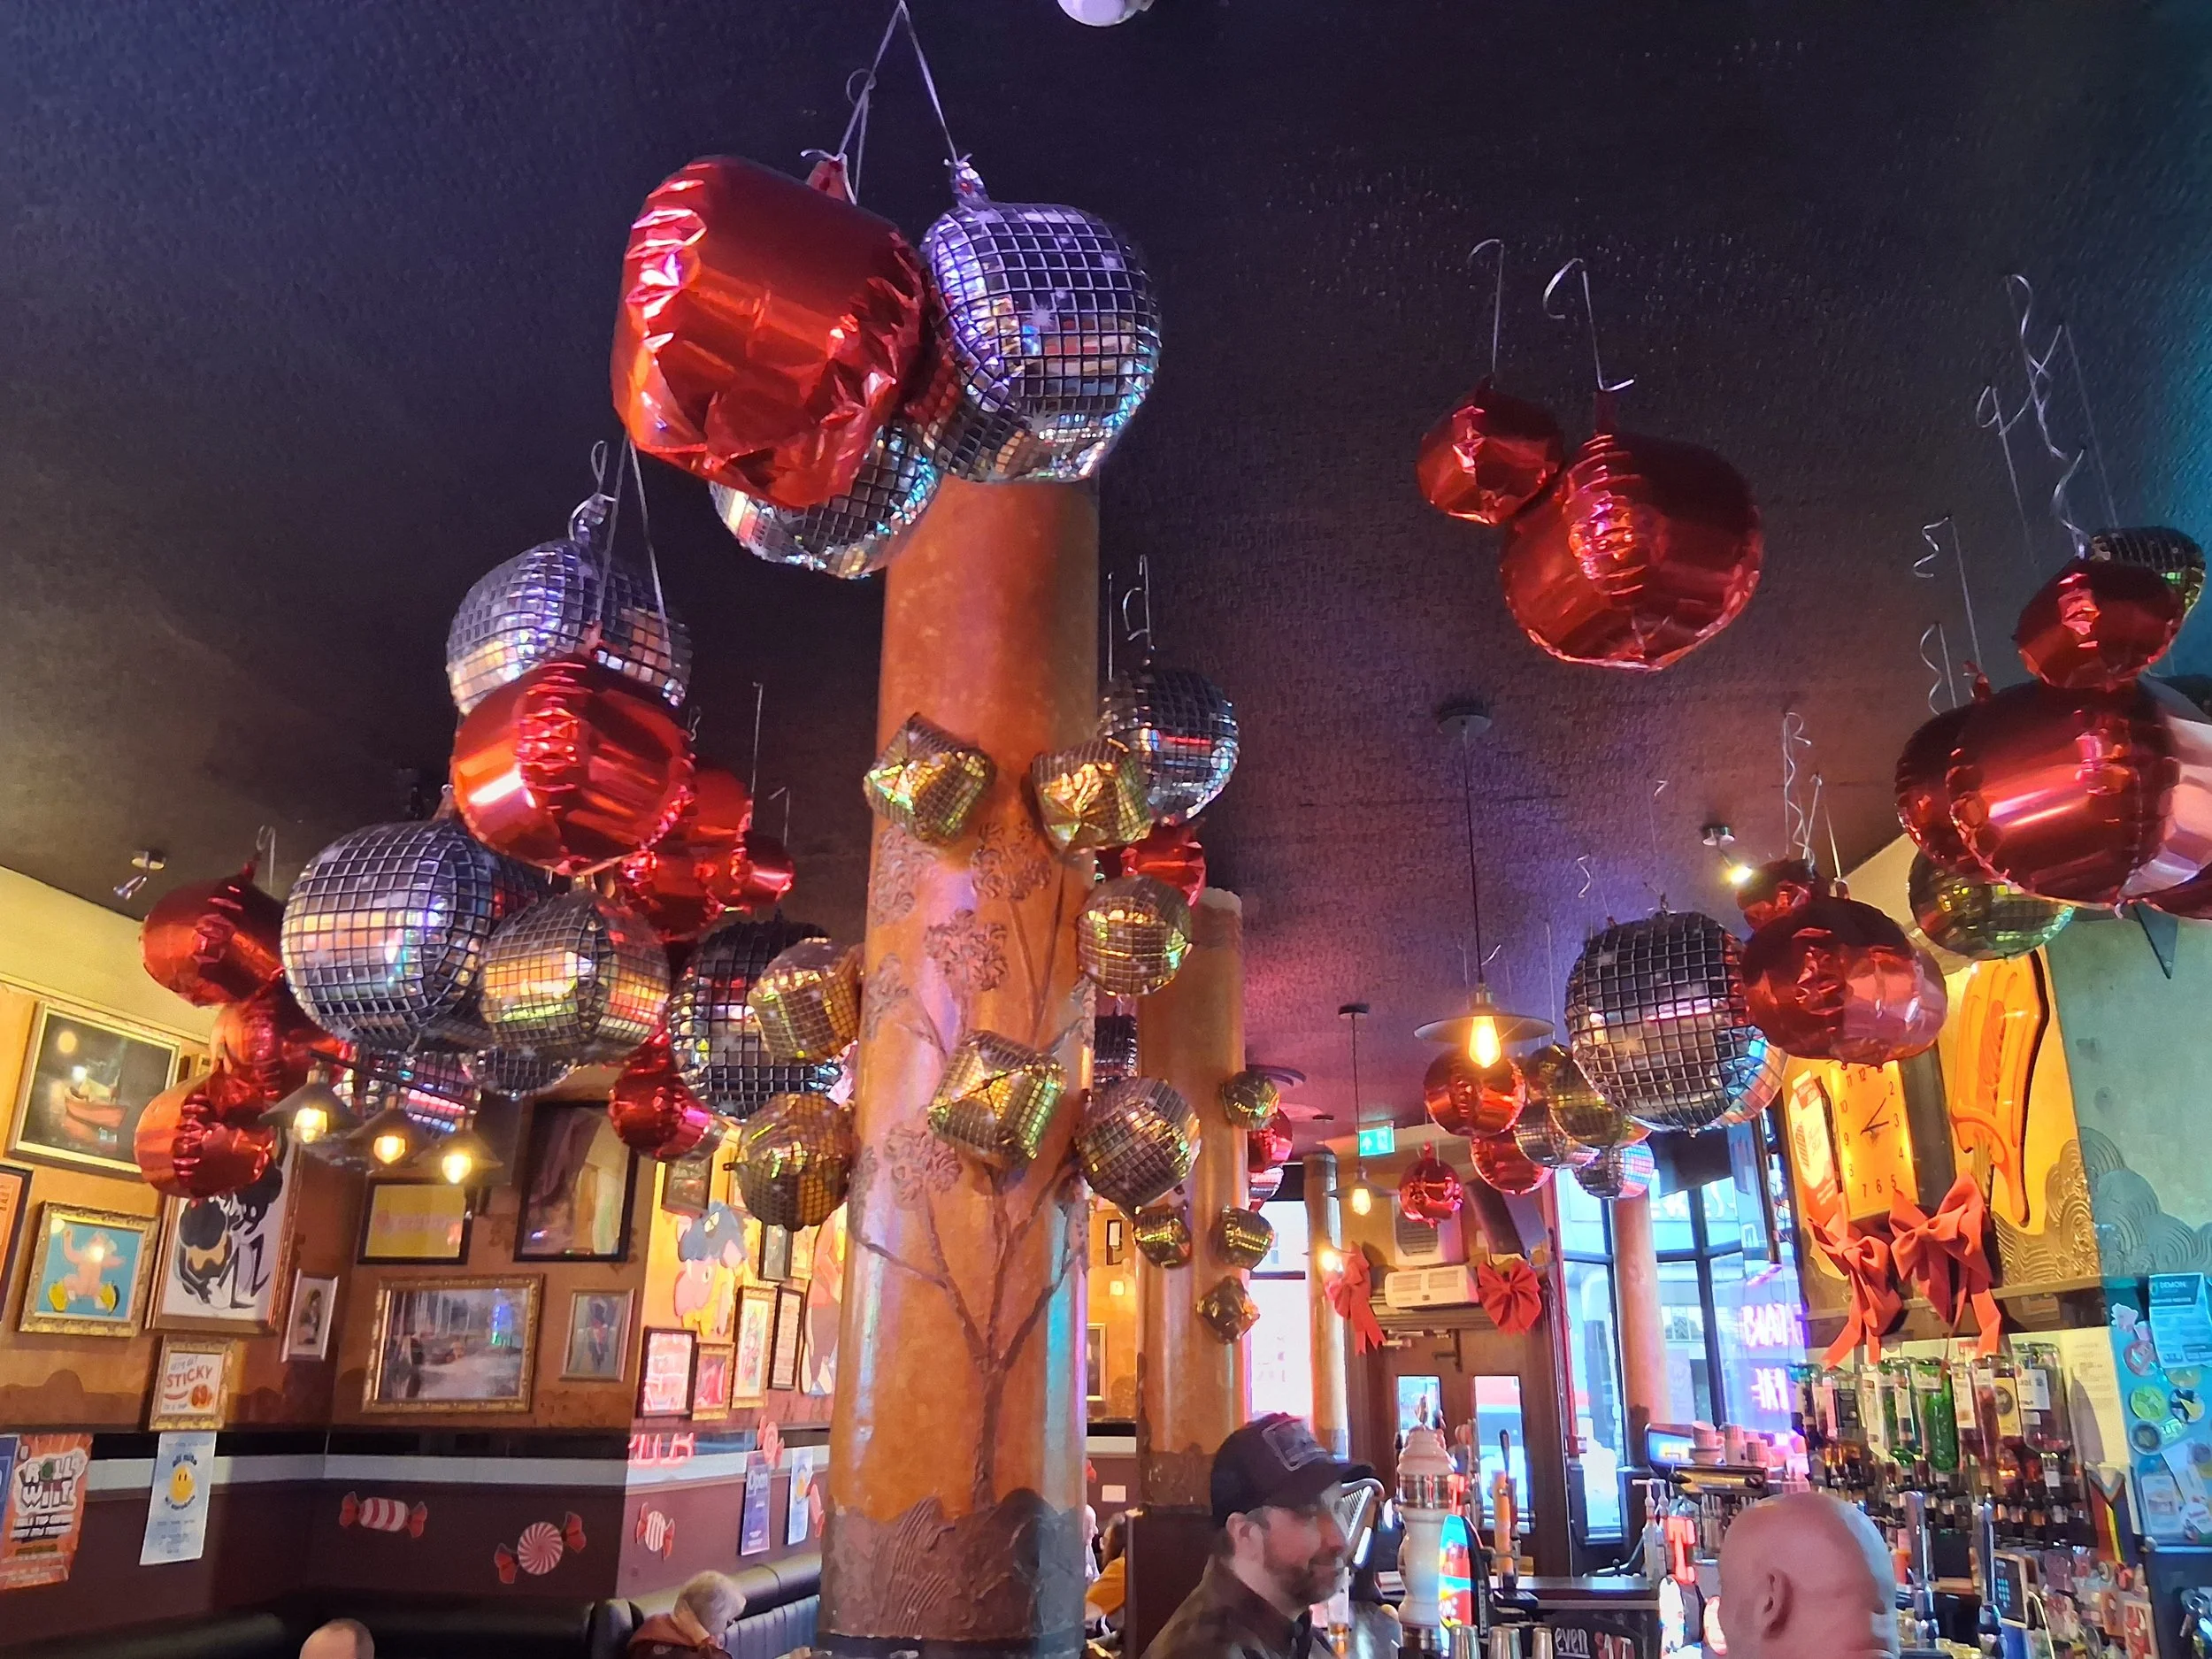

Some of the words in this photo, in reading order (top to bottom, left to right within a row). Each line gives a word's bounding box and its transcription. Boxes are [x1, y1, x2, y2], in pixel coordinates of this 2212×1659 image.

[1846, 1075, 1853, 1088] 11
[1858, 1067, 1866, 1081] 12
[1889, 1080, 1895, 1095] 2
[1839, 1099, 1848, 1113] 10
[1893, 1112, 1900, 1128] 3
[1843, 1132, 1849, 1146] 9
[1898, 1146, 1904, 1160] 4
[1876, 1179, 1883, 1194] 6
[1890, 1173, 1897, 1189] 5
[1862, 1183, 1868, 1198] 7
[165, 1365, 213, 1387] STICKY
[1555, 1627, 1589, 1654] even
